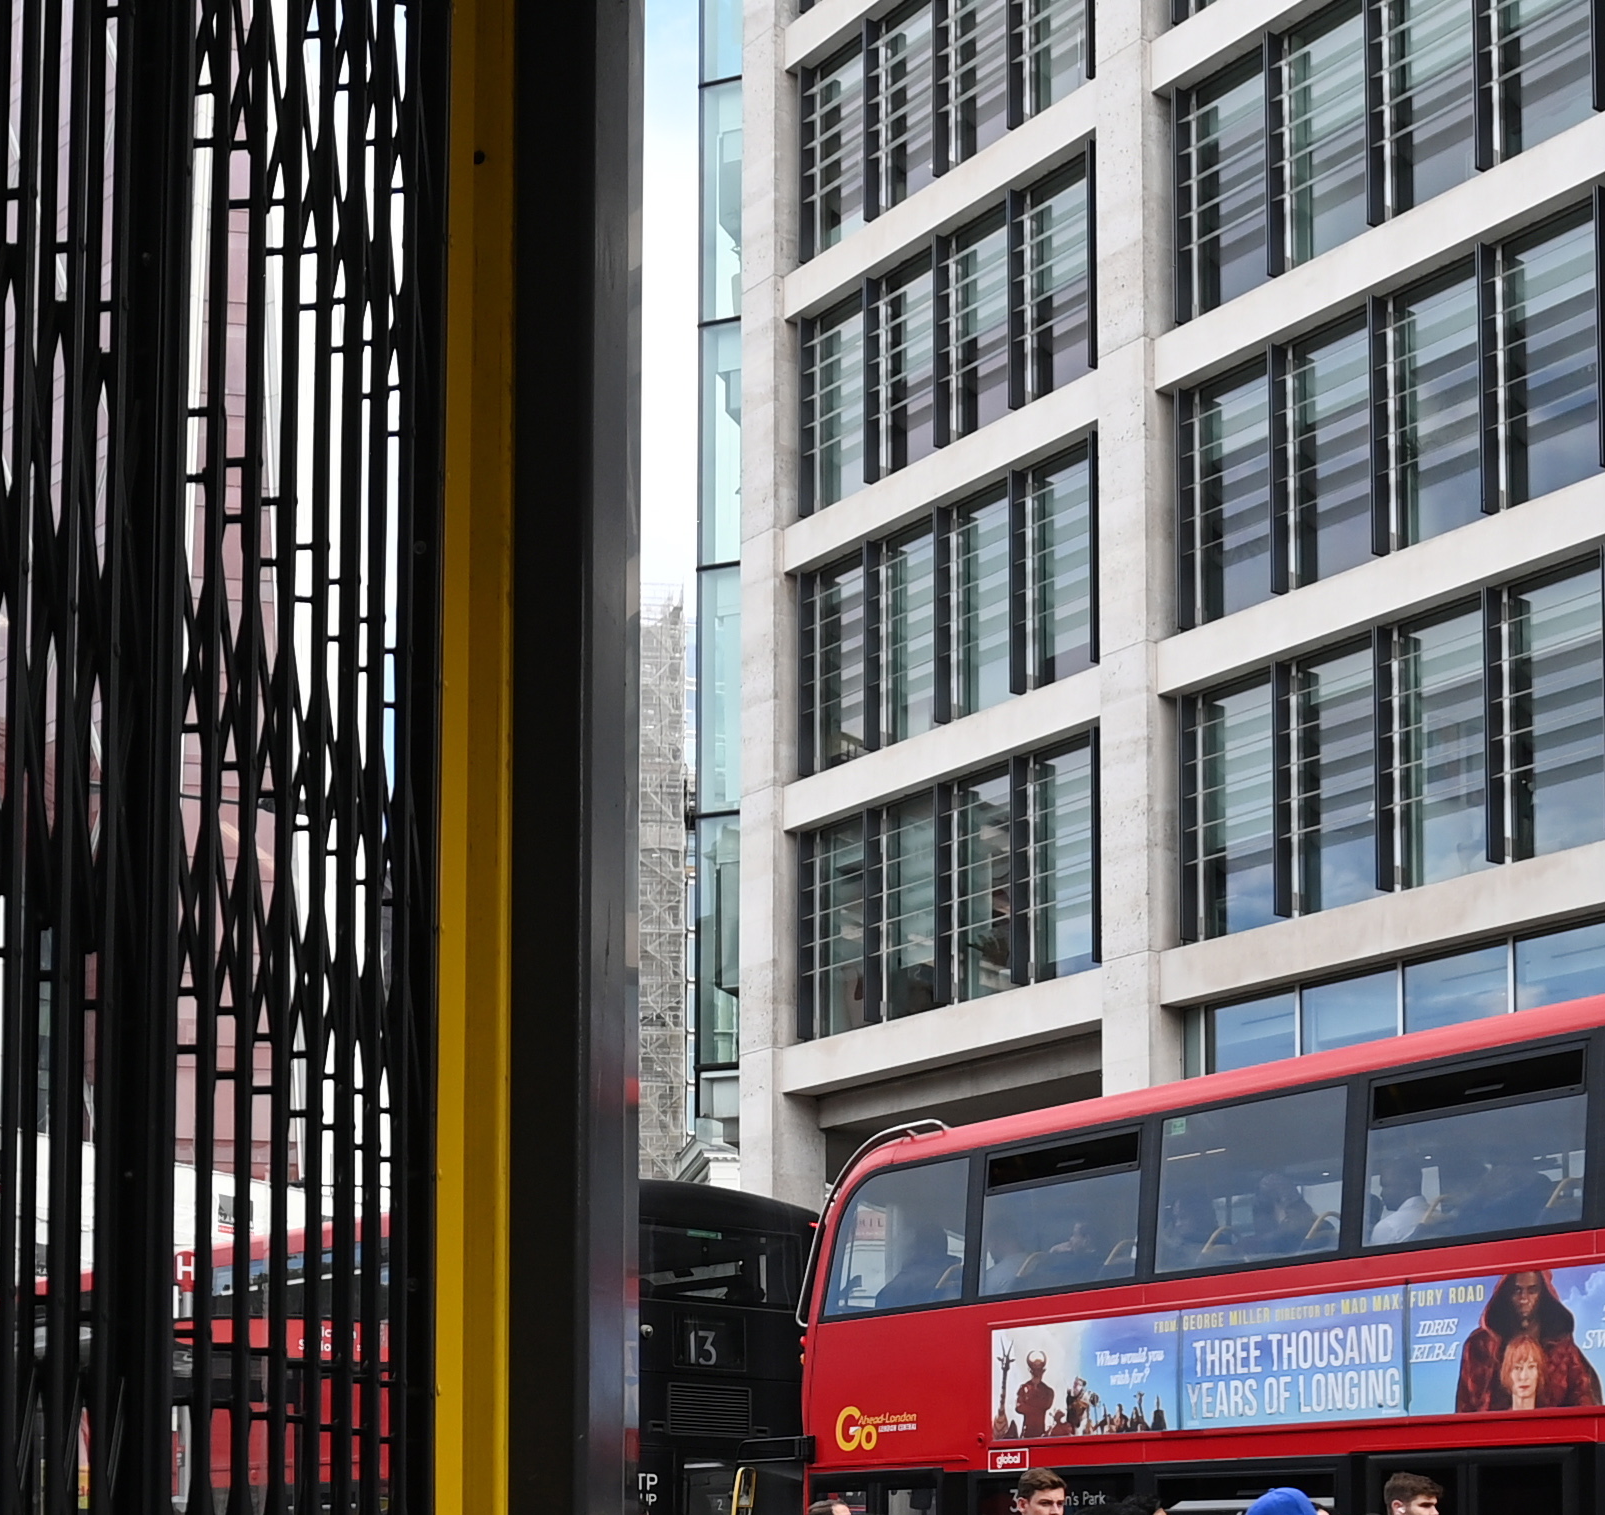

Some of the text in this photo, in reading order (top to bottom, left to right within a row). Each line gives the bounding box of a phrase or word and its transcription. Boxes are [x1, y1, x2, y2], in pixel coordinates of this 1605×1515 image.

[1153, 1319, 1178, 1334] FROM
[1182, 1312, 1225, 1331] GEORGE
[1229, 1307, 1271, 1326] MILLER
[1275, 1304, 1321, 1321] DIRECTOR
[1324, 1303, 1336, 1316] OF
[1341, 1297, 1368, 1315] MAD
[1409, 1288, 1444, 1308] FURY
[1448, 1284, 1485, 1304] ROAD
[1415, 1318, 1459, 1337] IDRIS
[689, 1330, 717, 1366] 13
[1095, 1346, 1165, 1367] What would you
[1191, 1322, 1394, 1378] THREE THOUSAND
[1409, 1341, 1460, 1363] ELBA
[1110, 1367, 1151, 1389] wish for?
[1186, 1367, 1401, 1419] YEARS OF LONGING
[835, 1405, 878, 1452] Go
[996, 1452, 1021, 1468] global
[717, 1500, 723, 1511] 2
[1009, 1488, 1020, 1513] 3
[1082, 1490, 1106, 1506] Park
